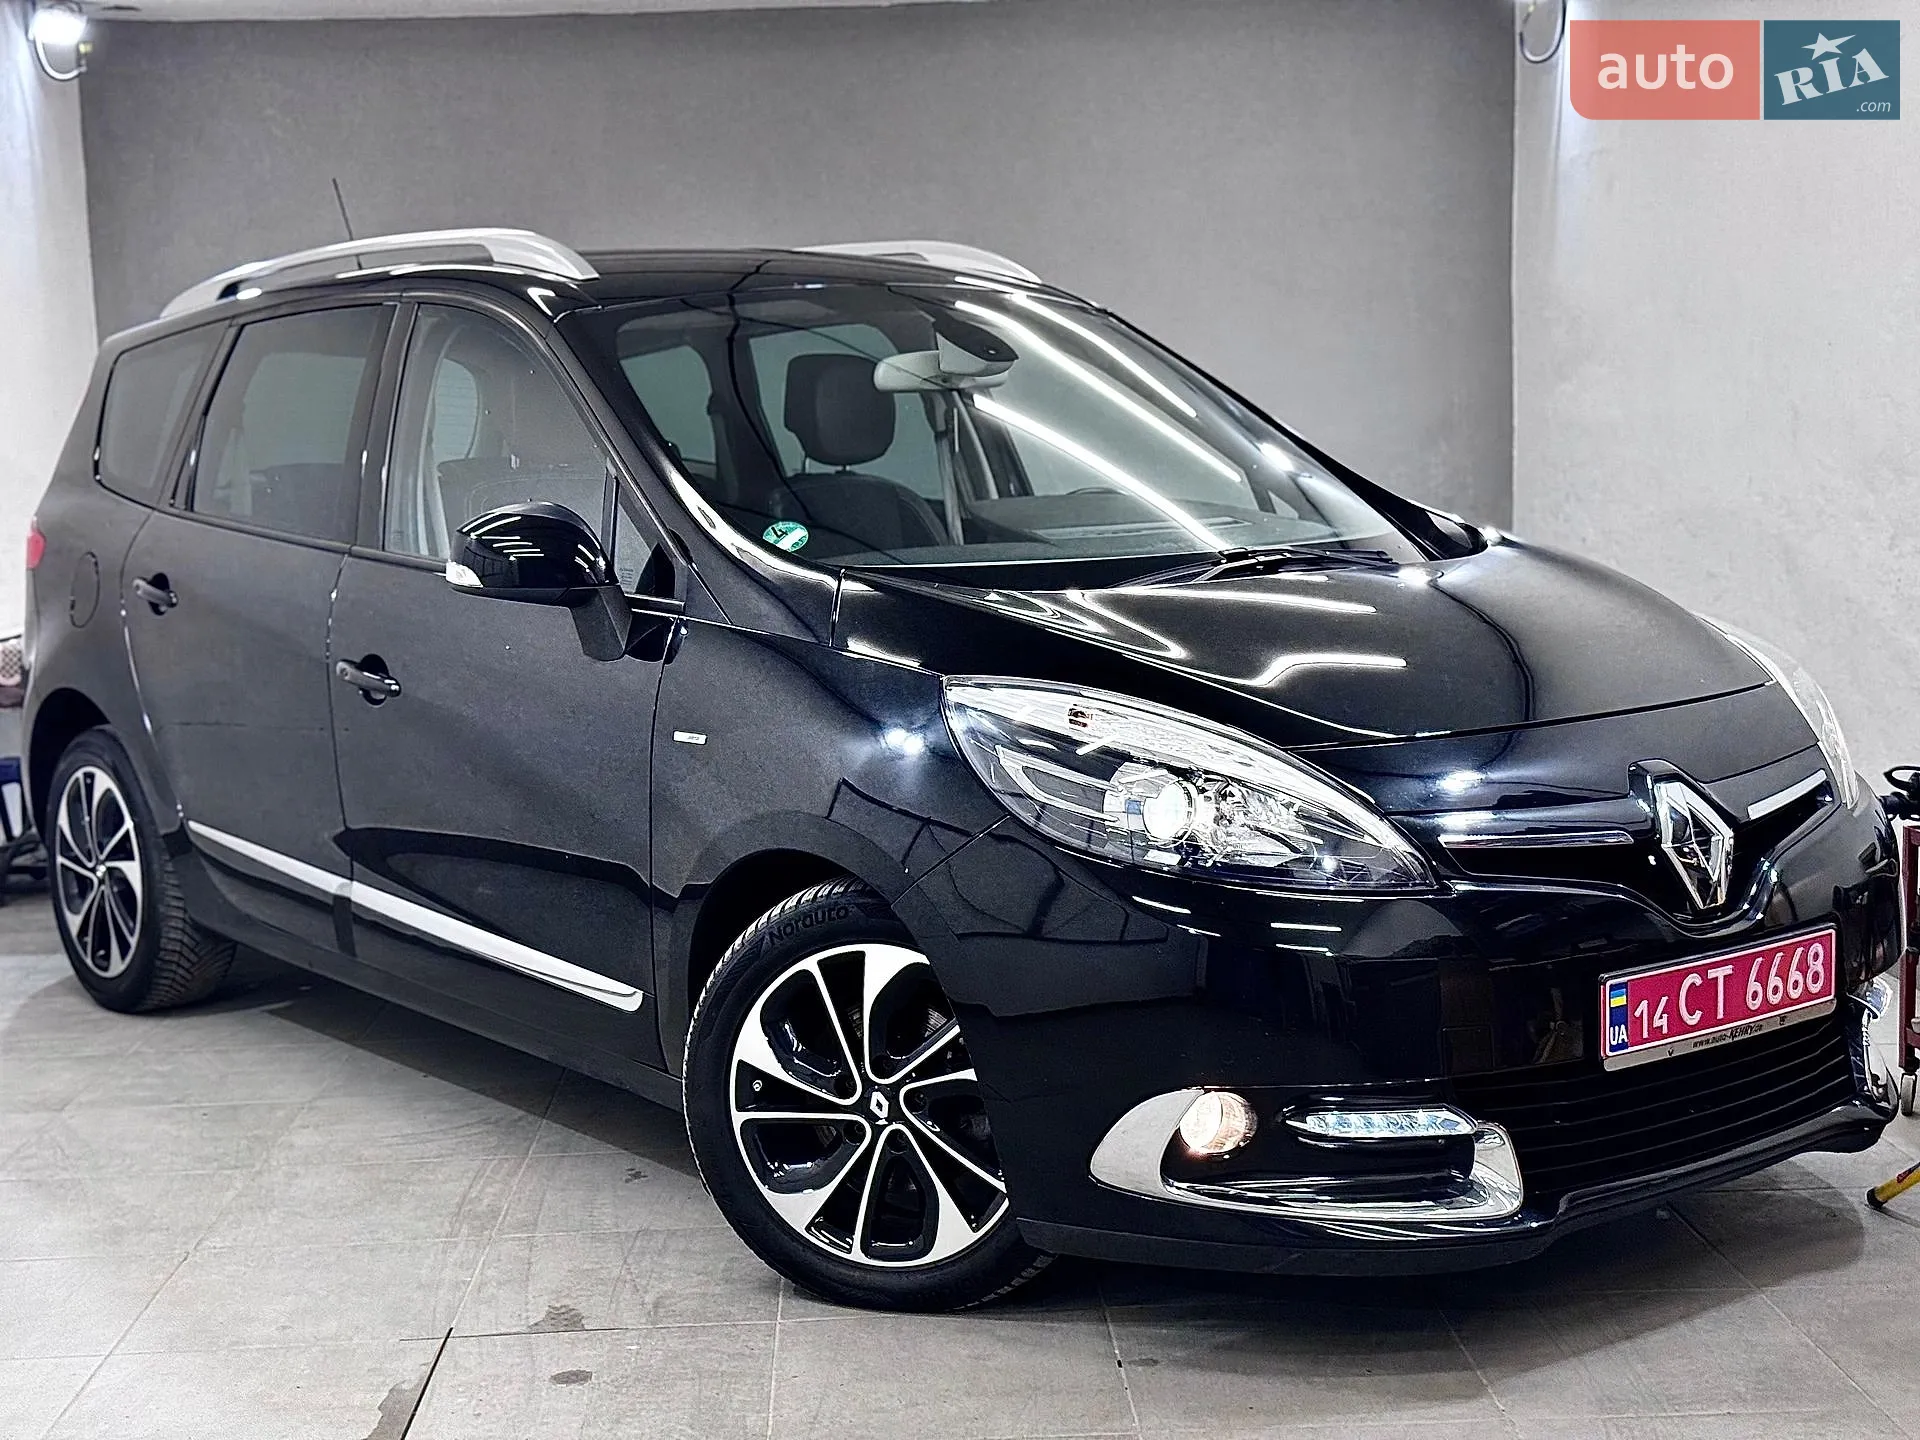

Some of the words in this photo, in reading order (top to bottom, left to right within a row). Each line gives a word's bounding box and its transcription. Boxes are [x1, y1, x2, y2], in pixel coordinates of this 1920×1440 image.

[769, 905, 849, 945] Norauto
[1633, 995, 1669, 1039] 14
[1678, 965, 1734, 1026] CT
[1746, 943, 1825, 1011] 6668
[1609, 1024, 1628, 1045] UA
